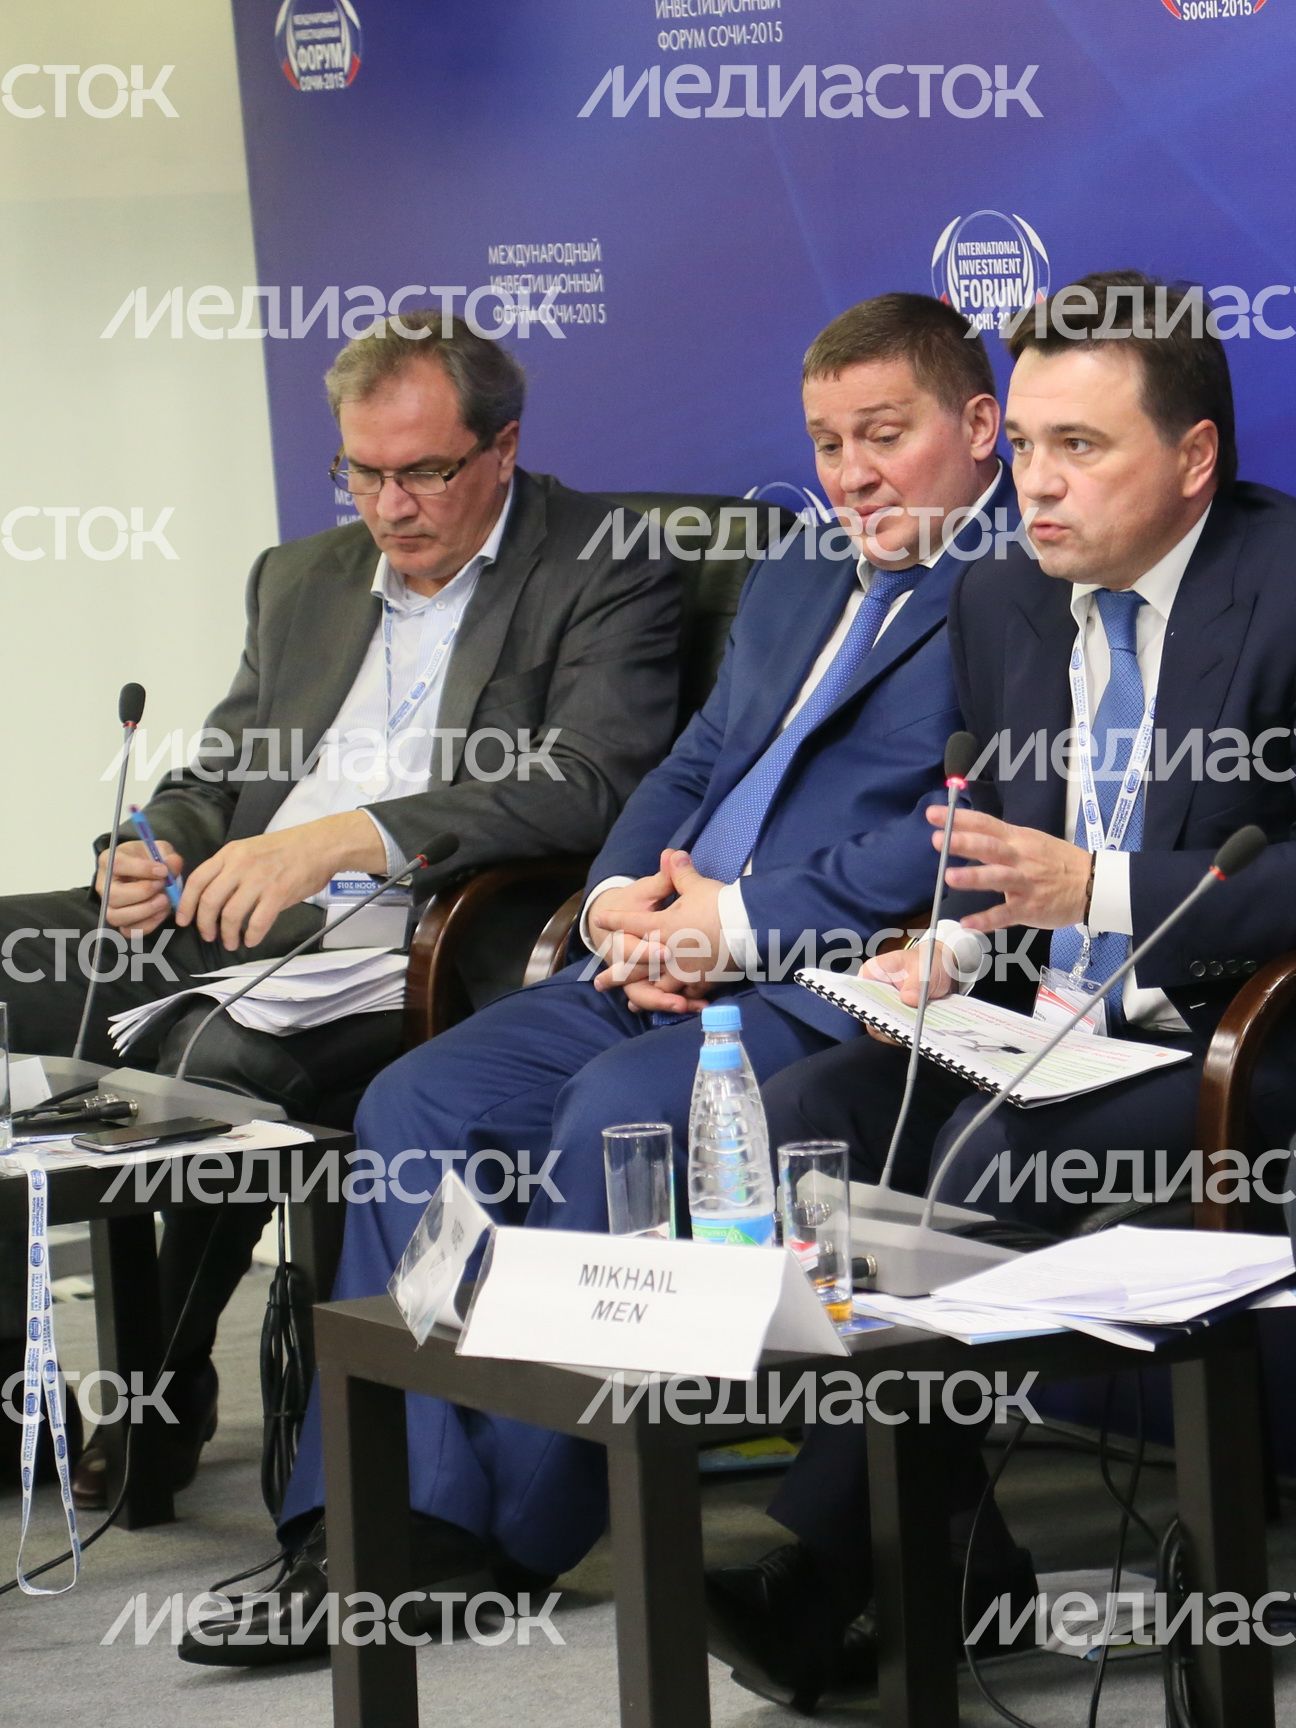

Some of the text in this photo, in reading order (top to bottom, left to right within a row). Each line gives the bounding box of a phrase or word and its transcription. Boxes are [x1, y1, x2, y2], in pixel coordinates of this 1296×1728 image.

[1182, 0, 1253, 20] SOCHI-2015
[657, 21, 783, 51] ФОРУМ СОЧИ-2015
[297, 43, 342, 72] ФОРУМ
[487, 238, 601, 267] МЕЖДУНАРОДНЫЙ
[957, 240, 1021, 256] INTERNATIONAL
[958, 257, 1021, 276] INVESTMENT
[960, 277, 1025, 308] FORUM
[578, 1263, 677, 1294] MIKHAIL
[591, 1300, 648, 1325] MEN
